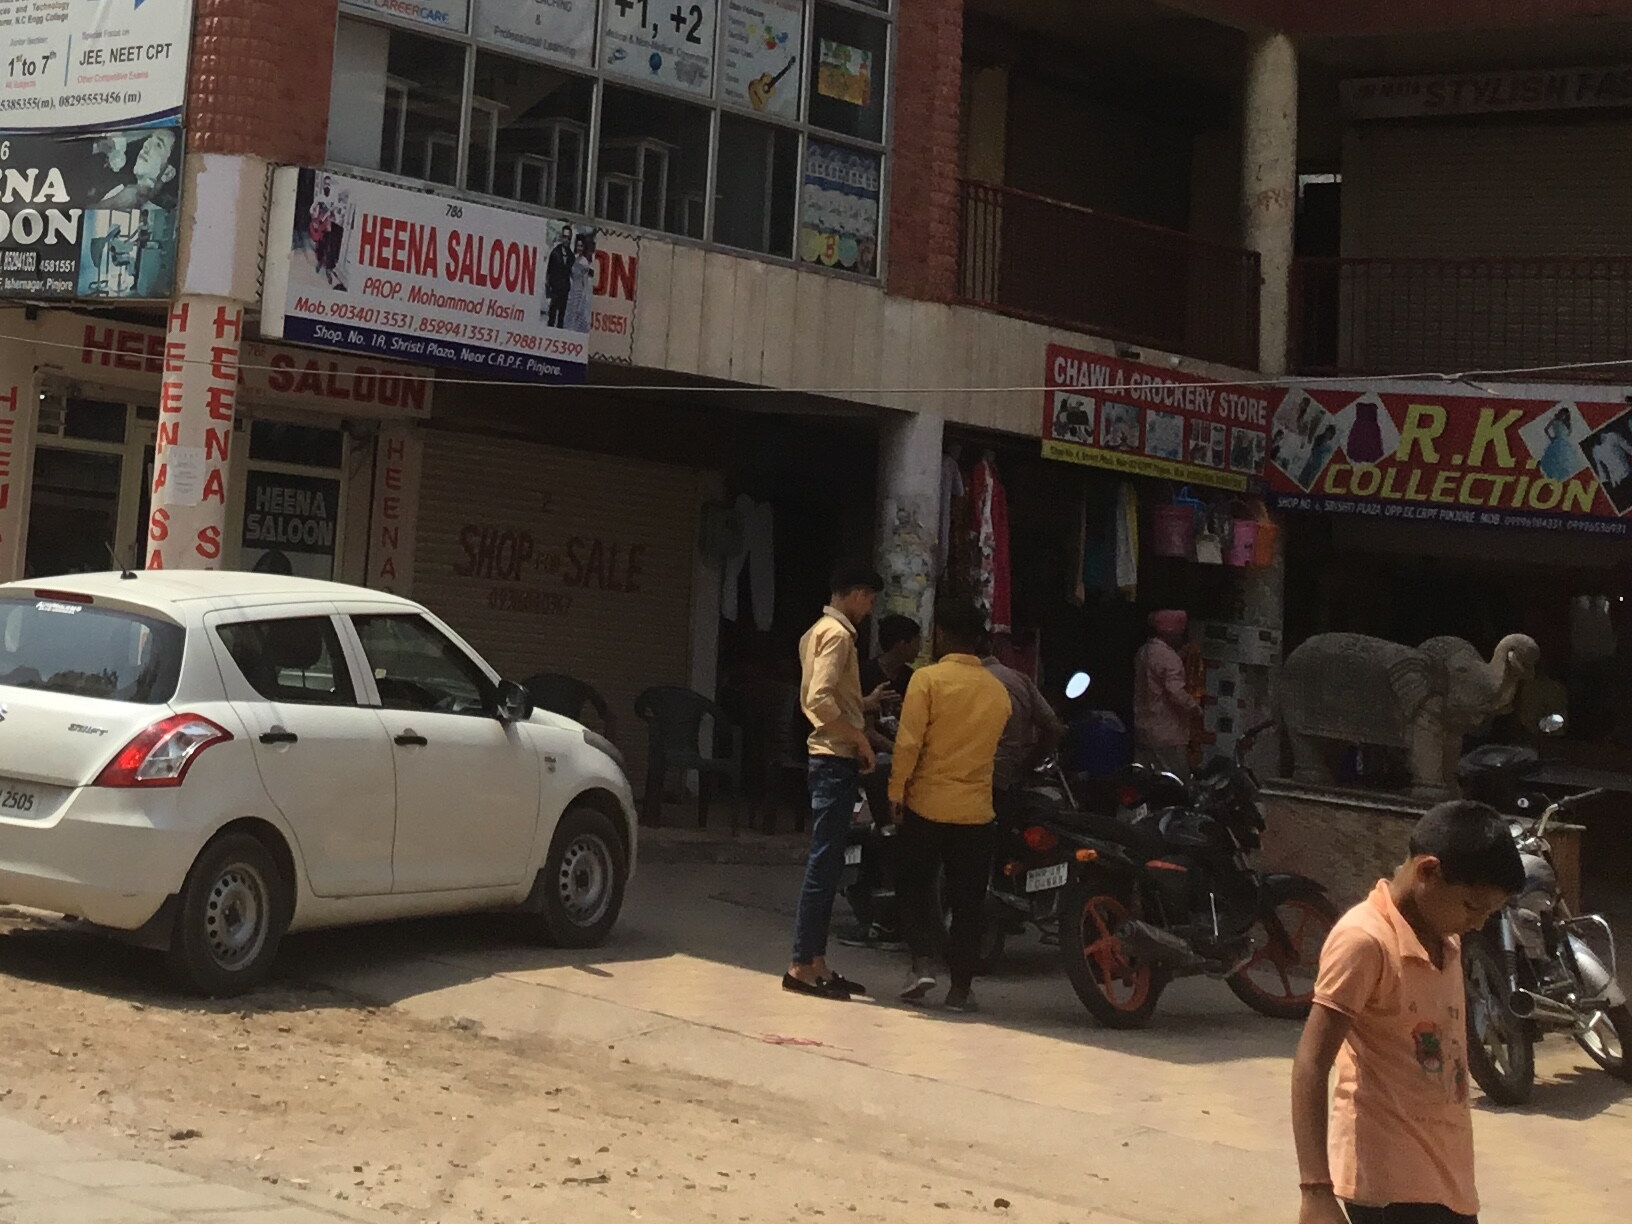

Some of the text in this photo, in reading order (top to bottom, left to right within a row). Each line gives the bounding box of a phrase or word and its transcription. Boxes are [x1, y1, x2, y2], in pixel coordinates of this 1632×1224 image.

[15, 5, 27, 13] and
[670, 4, 703, 44] +2
[22, 58, 36, 76] to
[79, 43, 172, 67] JEE, NEET CPT
[58, 91, 121, 107] 08295553456
[123, 91, 142, 104] (m)
[445, 204, 464, 219] 786
[359, 214, 539, 296] HEENA SALOON
[46, 278, 73, 293] Pinjore
[363, 277, 525, 323] PROP. Mohammad Kasim
[313, 324, 345, 344] Shop.
[347, 331, 366, 345] No.
[390, 337, 425, 354] Shristi
[426, 342, 457, 362] Plaza,
[460, 347, 485, 363] Near
[526, 359, 563, 377] Pinjore.
[268, 353, 427, 410] SALOON
[1054, 355, 1268, 425] CHAWLA CROCKERY STORE
[201, 305, 242, 506] HEENA
[255, 484, 326, 520] HEENA
[1323, 462, 1599, 513] COLLECTION
[1277, 497, 1298, 508] SHOP
[1356, 503, 1381, 515] PLAZA
[245, 513, 333, 548] SALOON
[454, 525, 534, 582] SHOP
[564, 535, 648, 593] SALE
[2, 791, 35, 811] 2505
